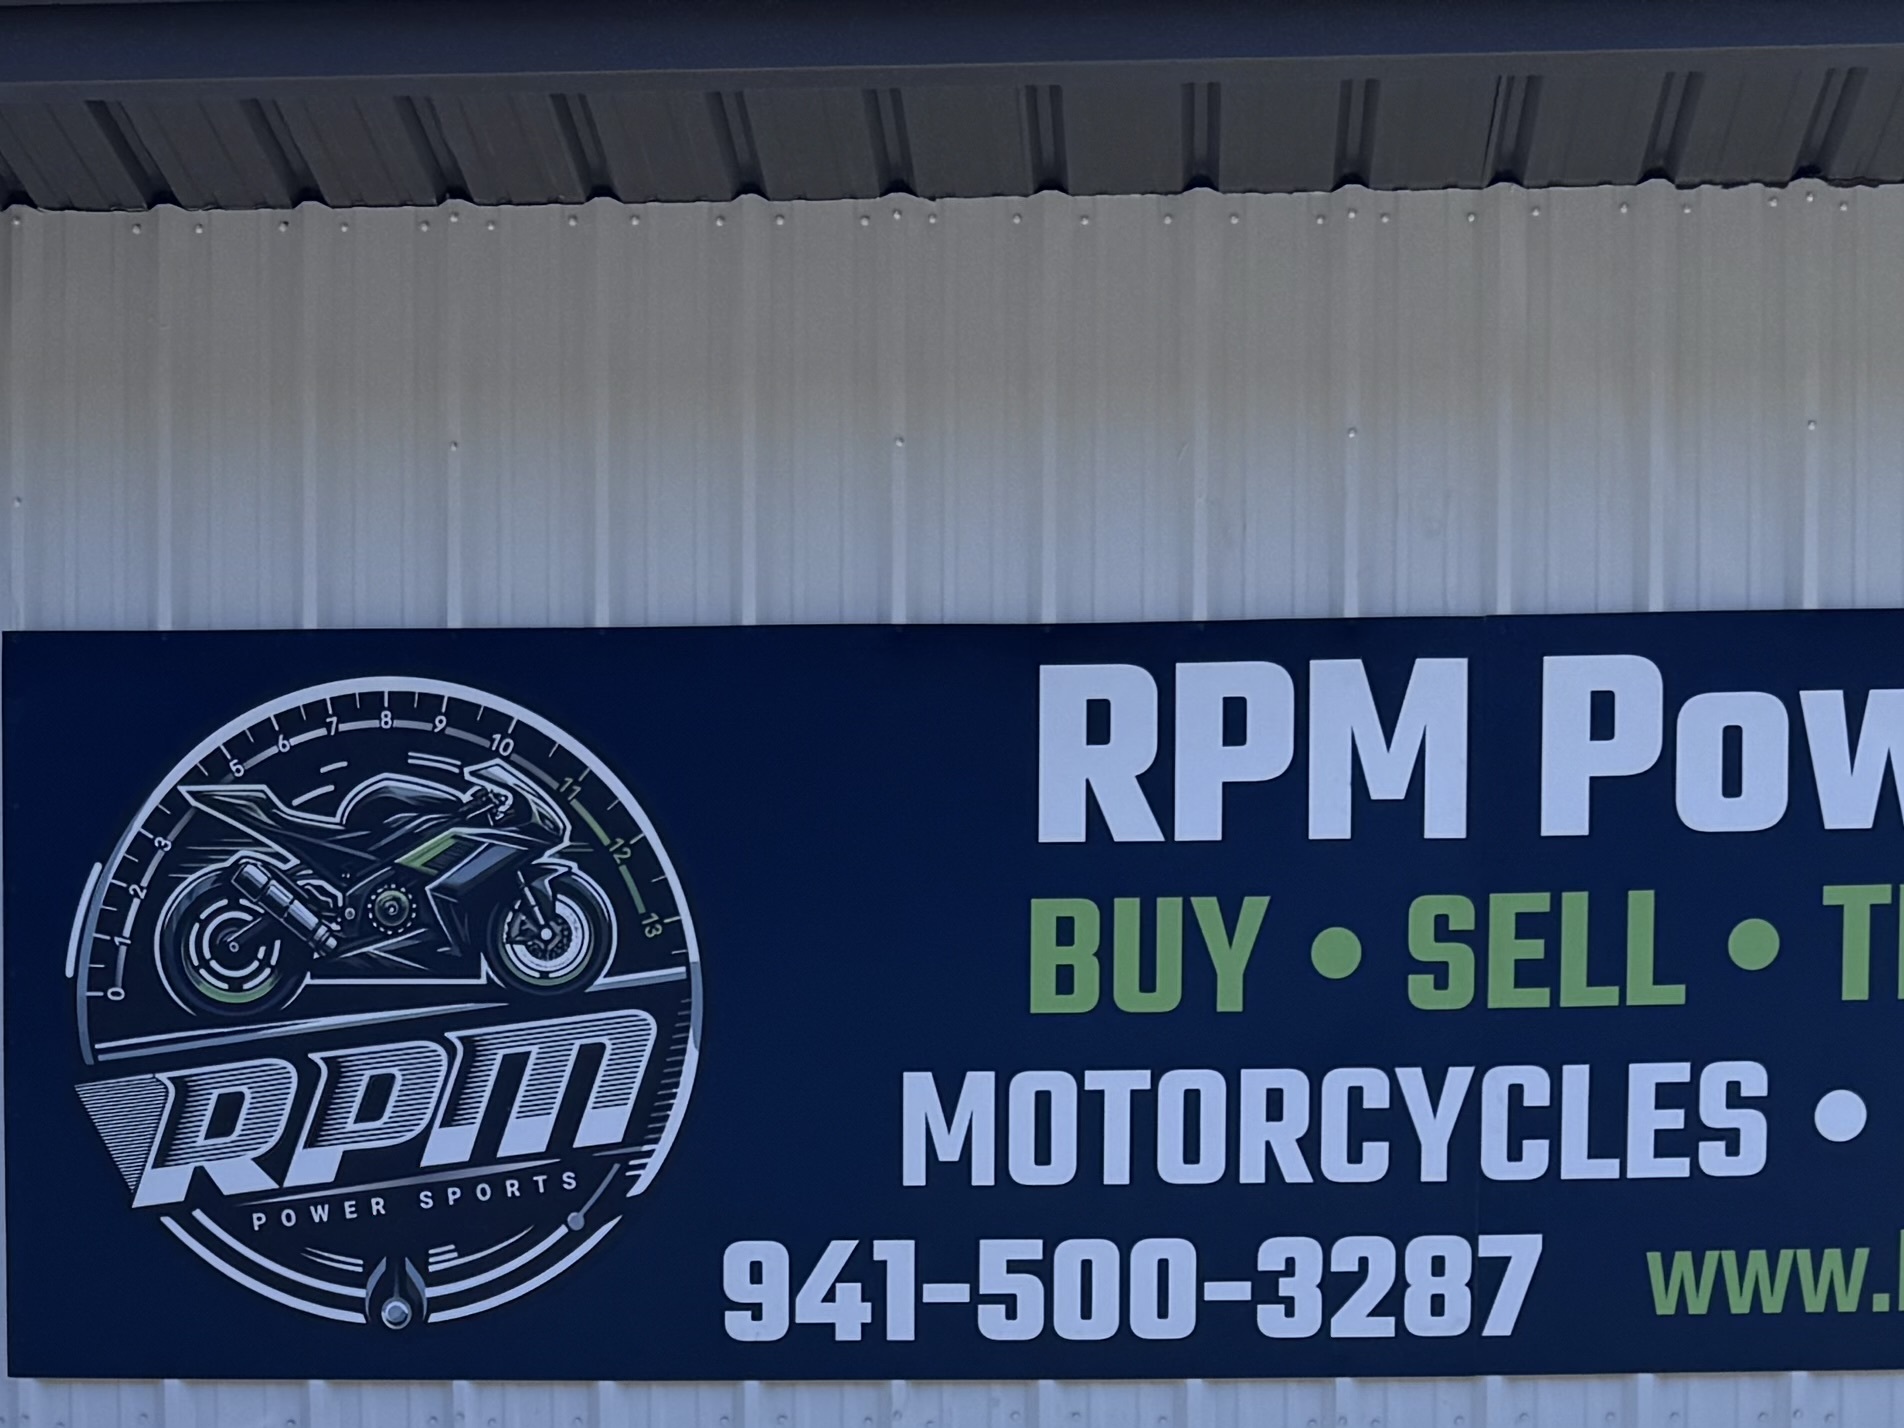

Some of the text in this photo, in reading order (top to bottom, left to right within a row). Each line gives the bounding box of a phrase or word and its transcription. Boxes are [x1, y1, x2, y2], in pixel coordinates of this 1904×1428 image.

[1039, 657, 1469, 843] RPM
[155, 835, 172, 853] 3
[230, 759, 245, 778] 5
[278, 734, 290, 754] 6
[325, 716, 339, 735] 7
[379, 711, 392, 729] 8
[434, 714, 447, 733] 9
[490, 734, 514, 757] 10
[558, 777, 582, 793] 11
[610, 837, 632, 864] 12
[643, 914, 662, 939] 13
[1029, 895, 1271, 1014] BUY
[1407, 889, 1686, 1010] SELL
[132, 1009, 658, 1208] RPM
[902, 1060, 1769, 1187] MOTORCYCLES
[252, 1170, 578, 1231] POWER SPORTS
[723, 1233, 1543, 1342] 941-500-3287
